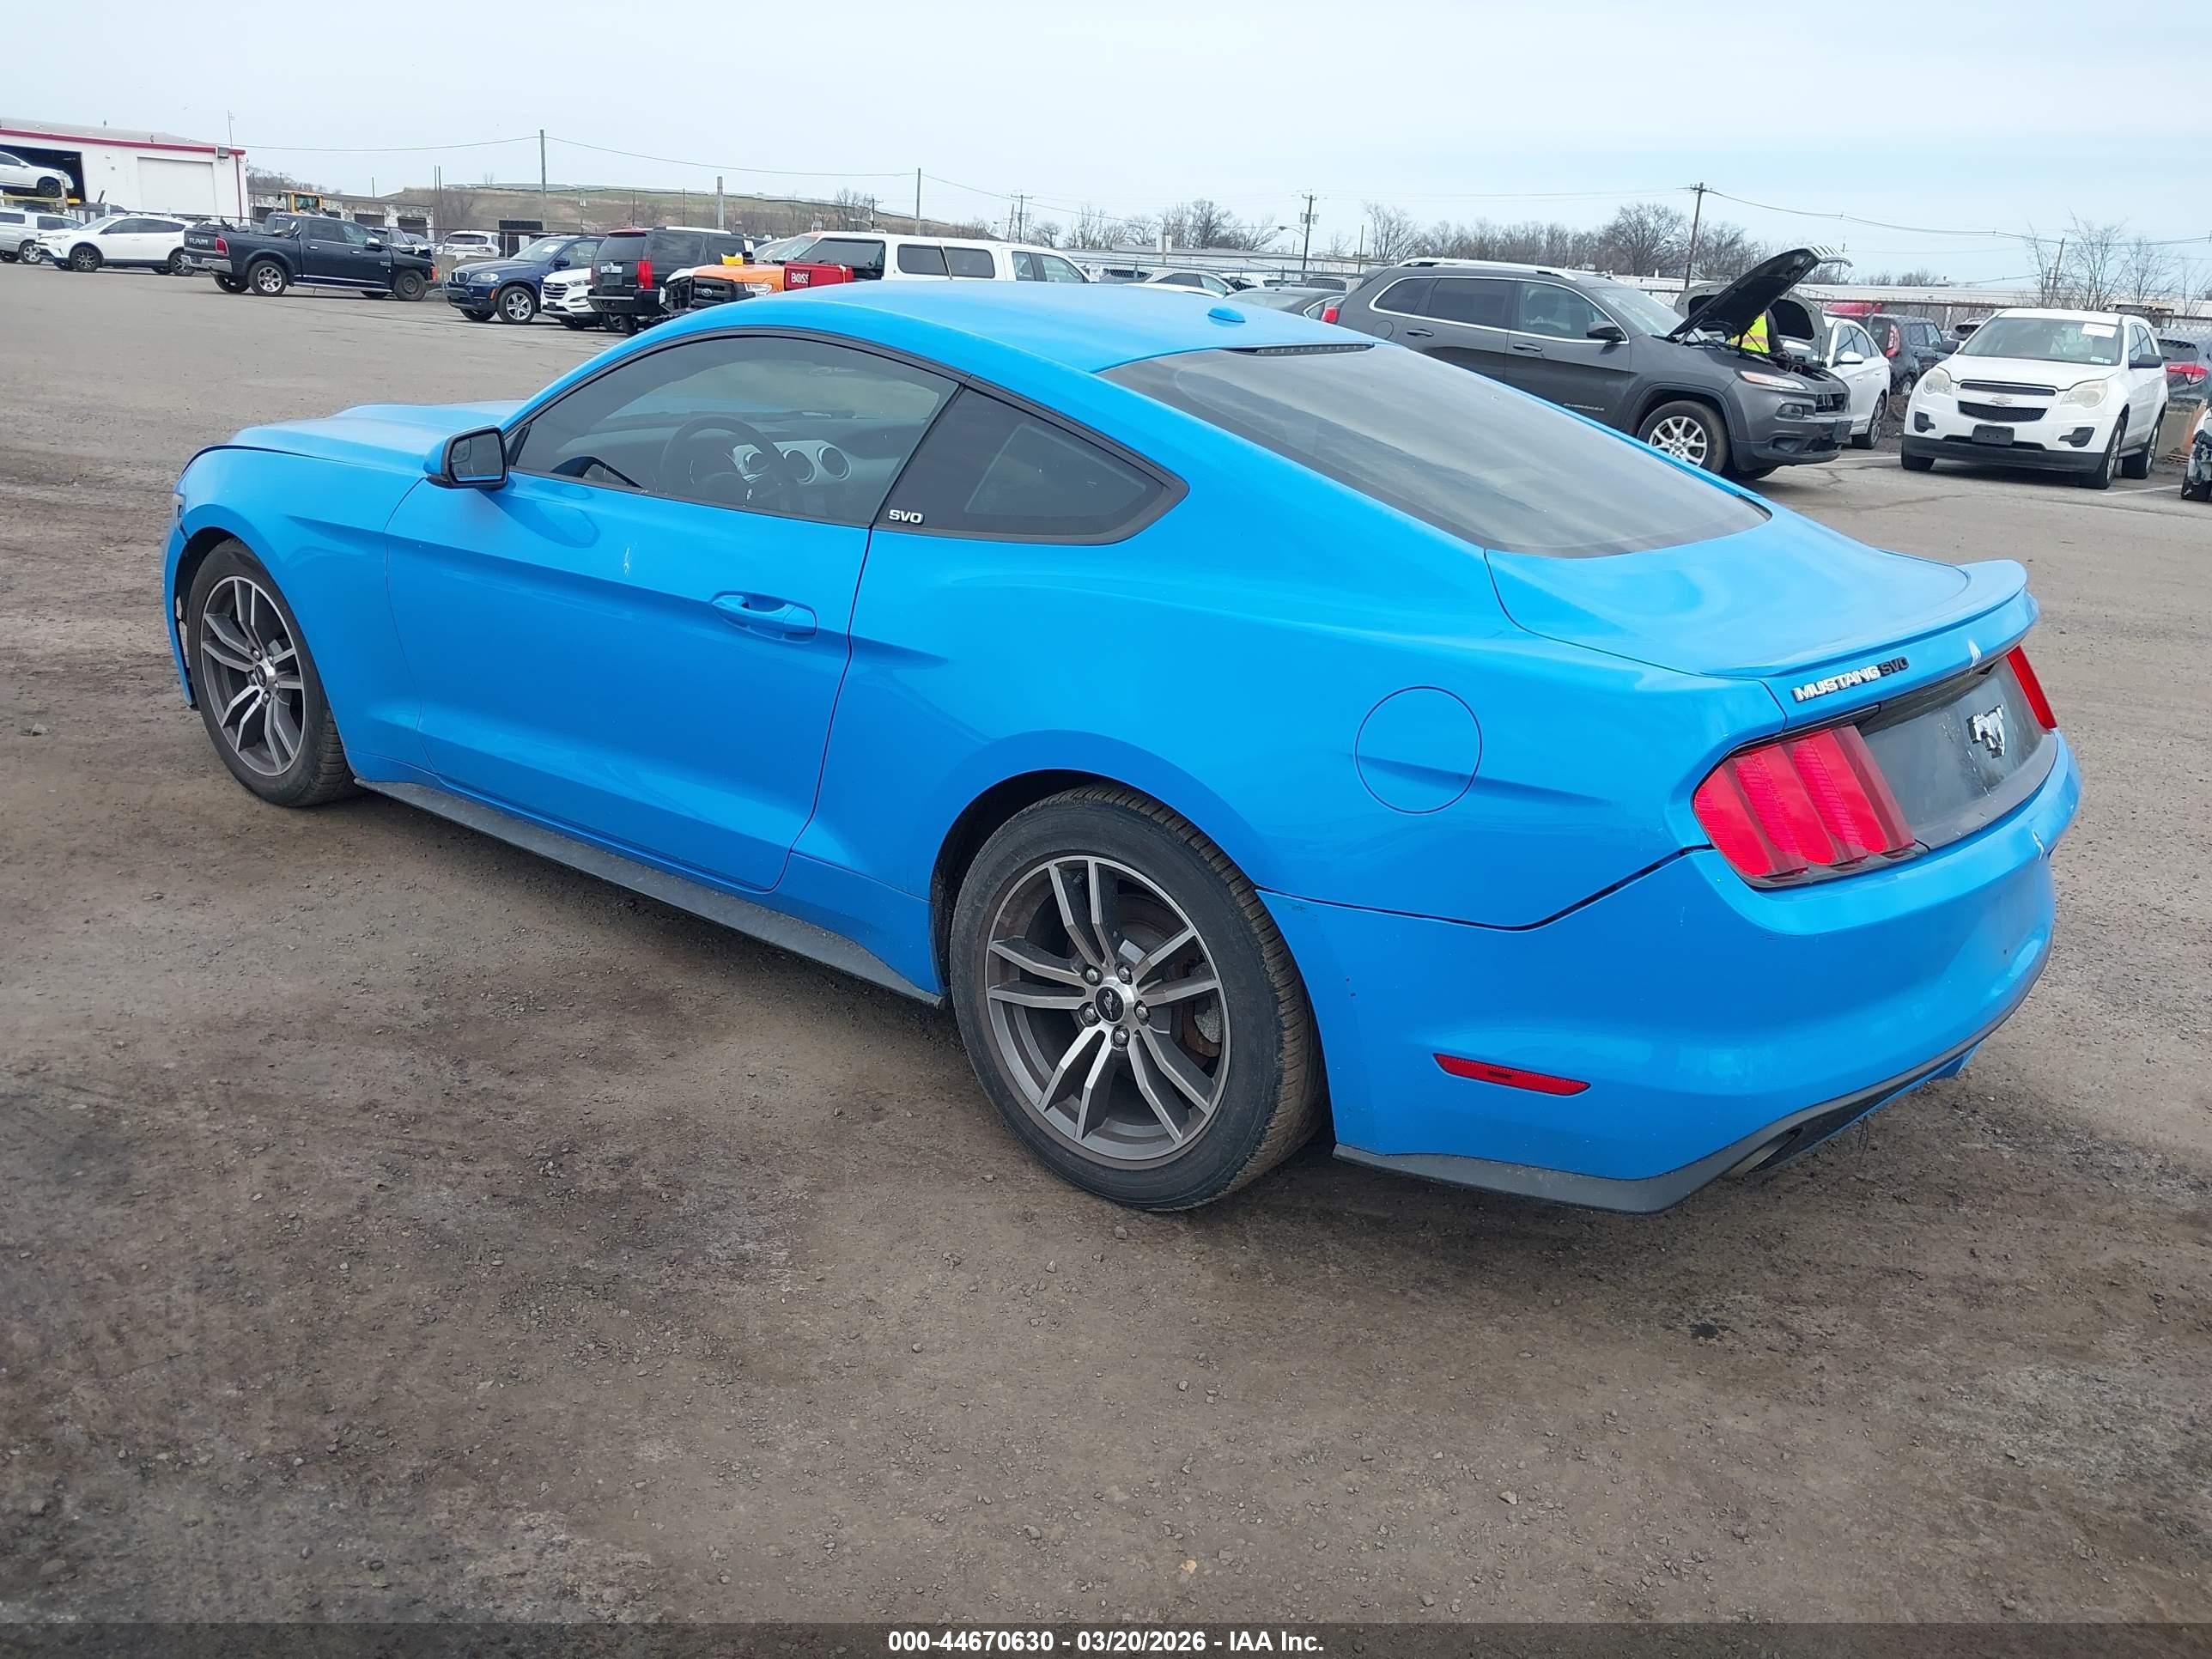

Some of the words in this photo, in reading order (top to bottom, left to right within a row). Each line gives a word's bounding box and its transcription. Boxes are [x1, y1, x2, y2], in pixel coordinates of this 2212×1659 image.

[188, 237, 209, 246] RAM
[791, 272, 809, 284] BOSS
[888, 508, 924, 524] SVO
[1793, 665, 1881, 702] MUSTANG
[1879, 657, 1909, 676] SVO
